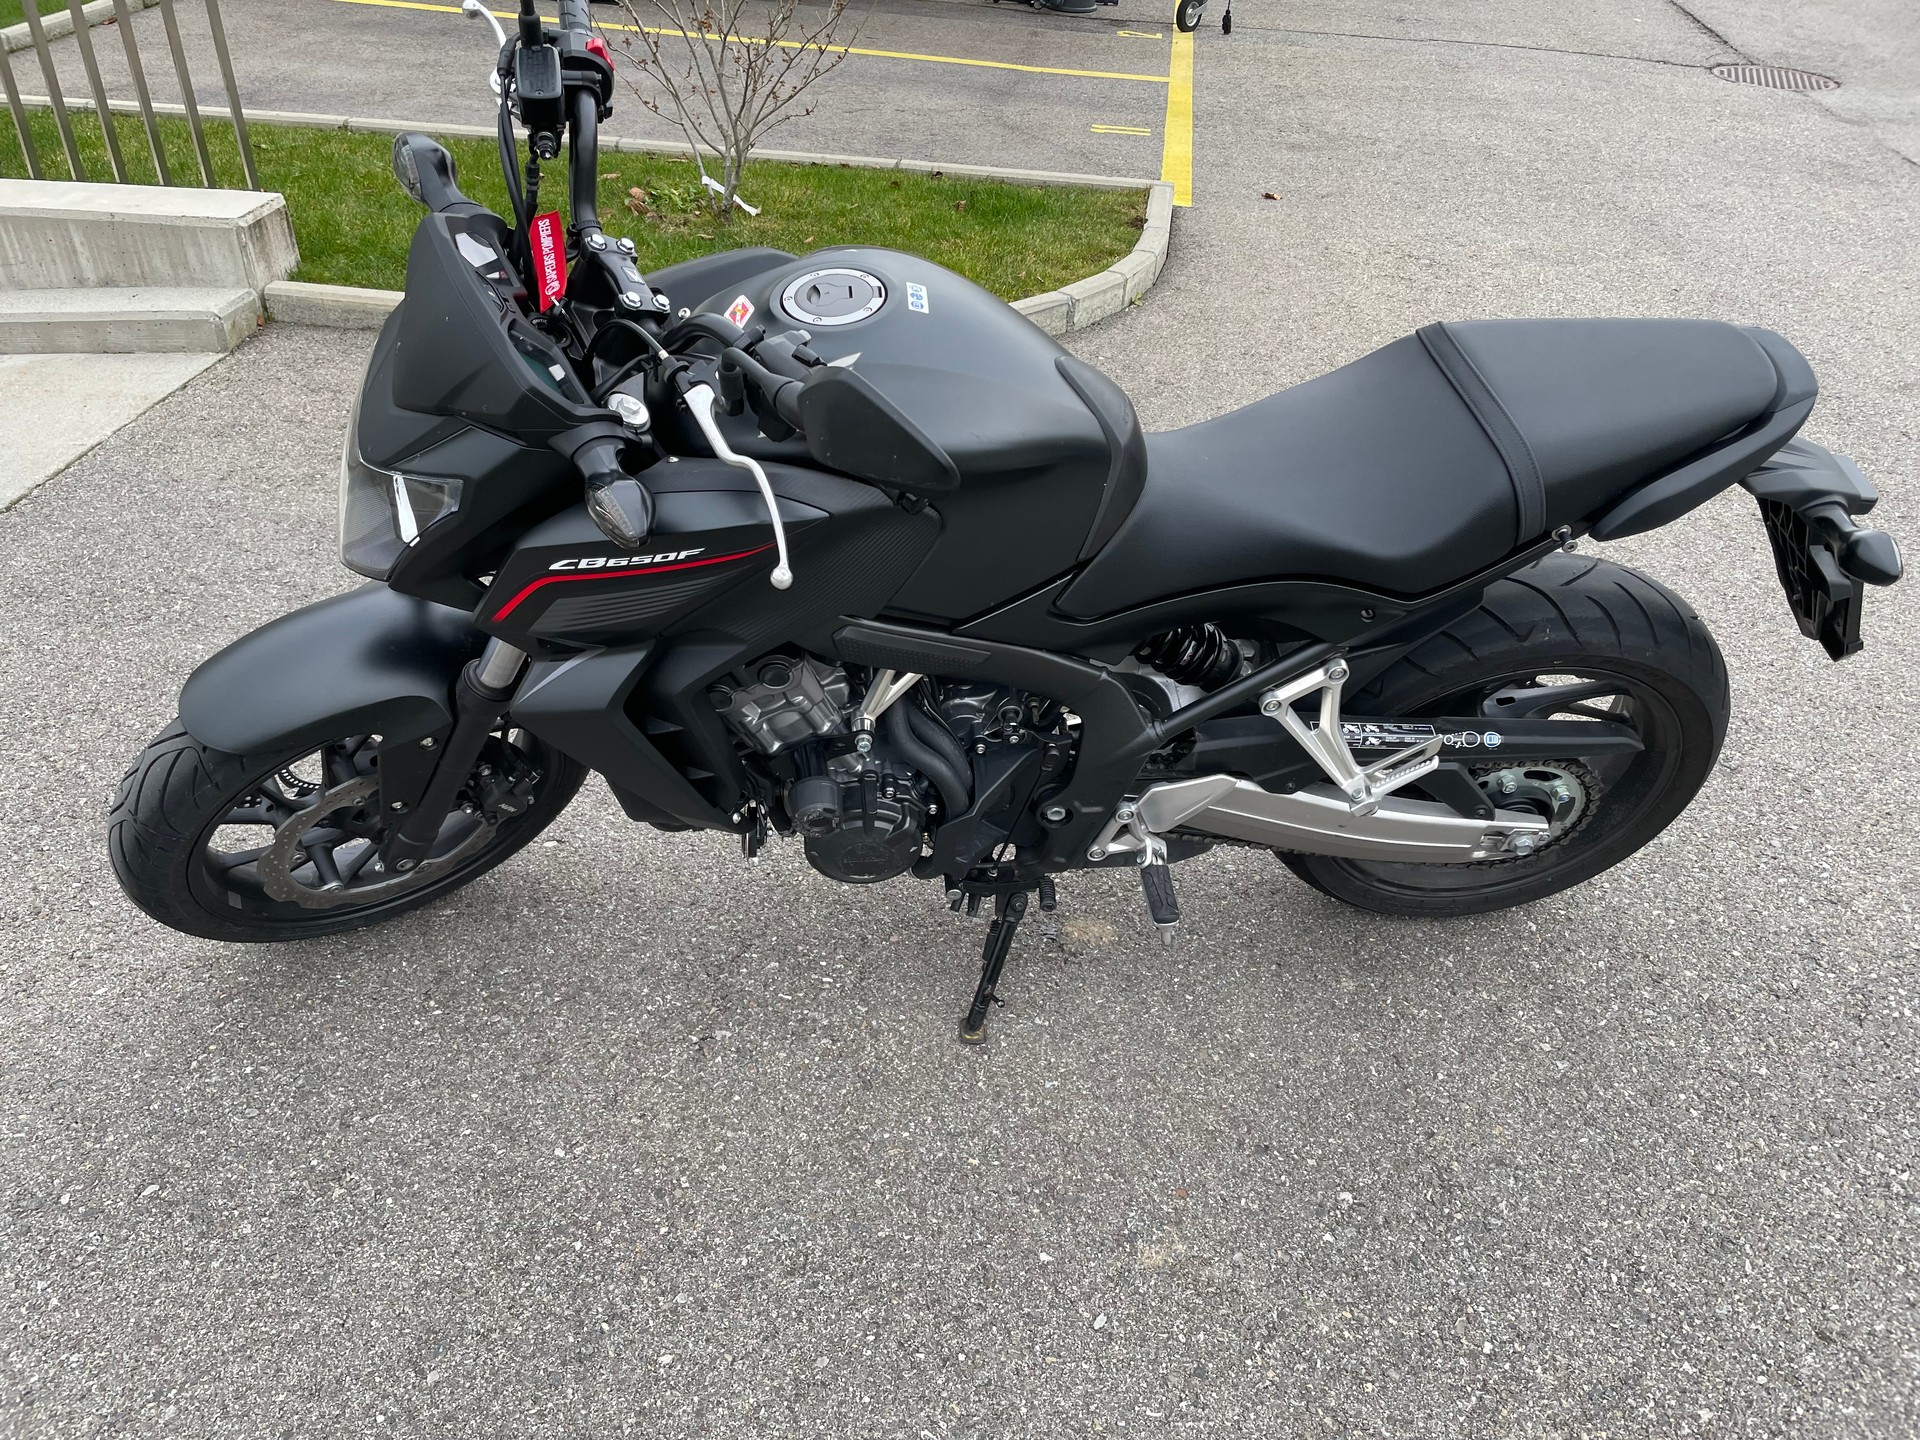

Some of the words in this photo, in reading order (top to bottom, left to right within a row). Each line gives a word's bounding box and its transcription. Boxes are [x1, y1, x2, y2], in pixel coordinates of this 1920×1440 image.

[538, 218, 554, 255] POMPIERS
[543, 253, 557, 284] SAPEURS
[548, 547, 706, 570] CB650F
